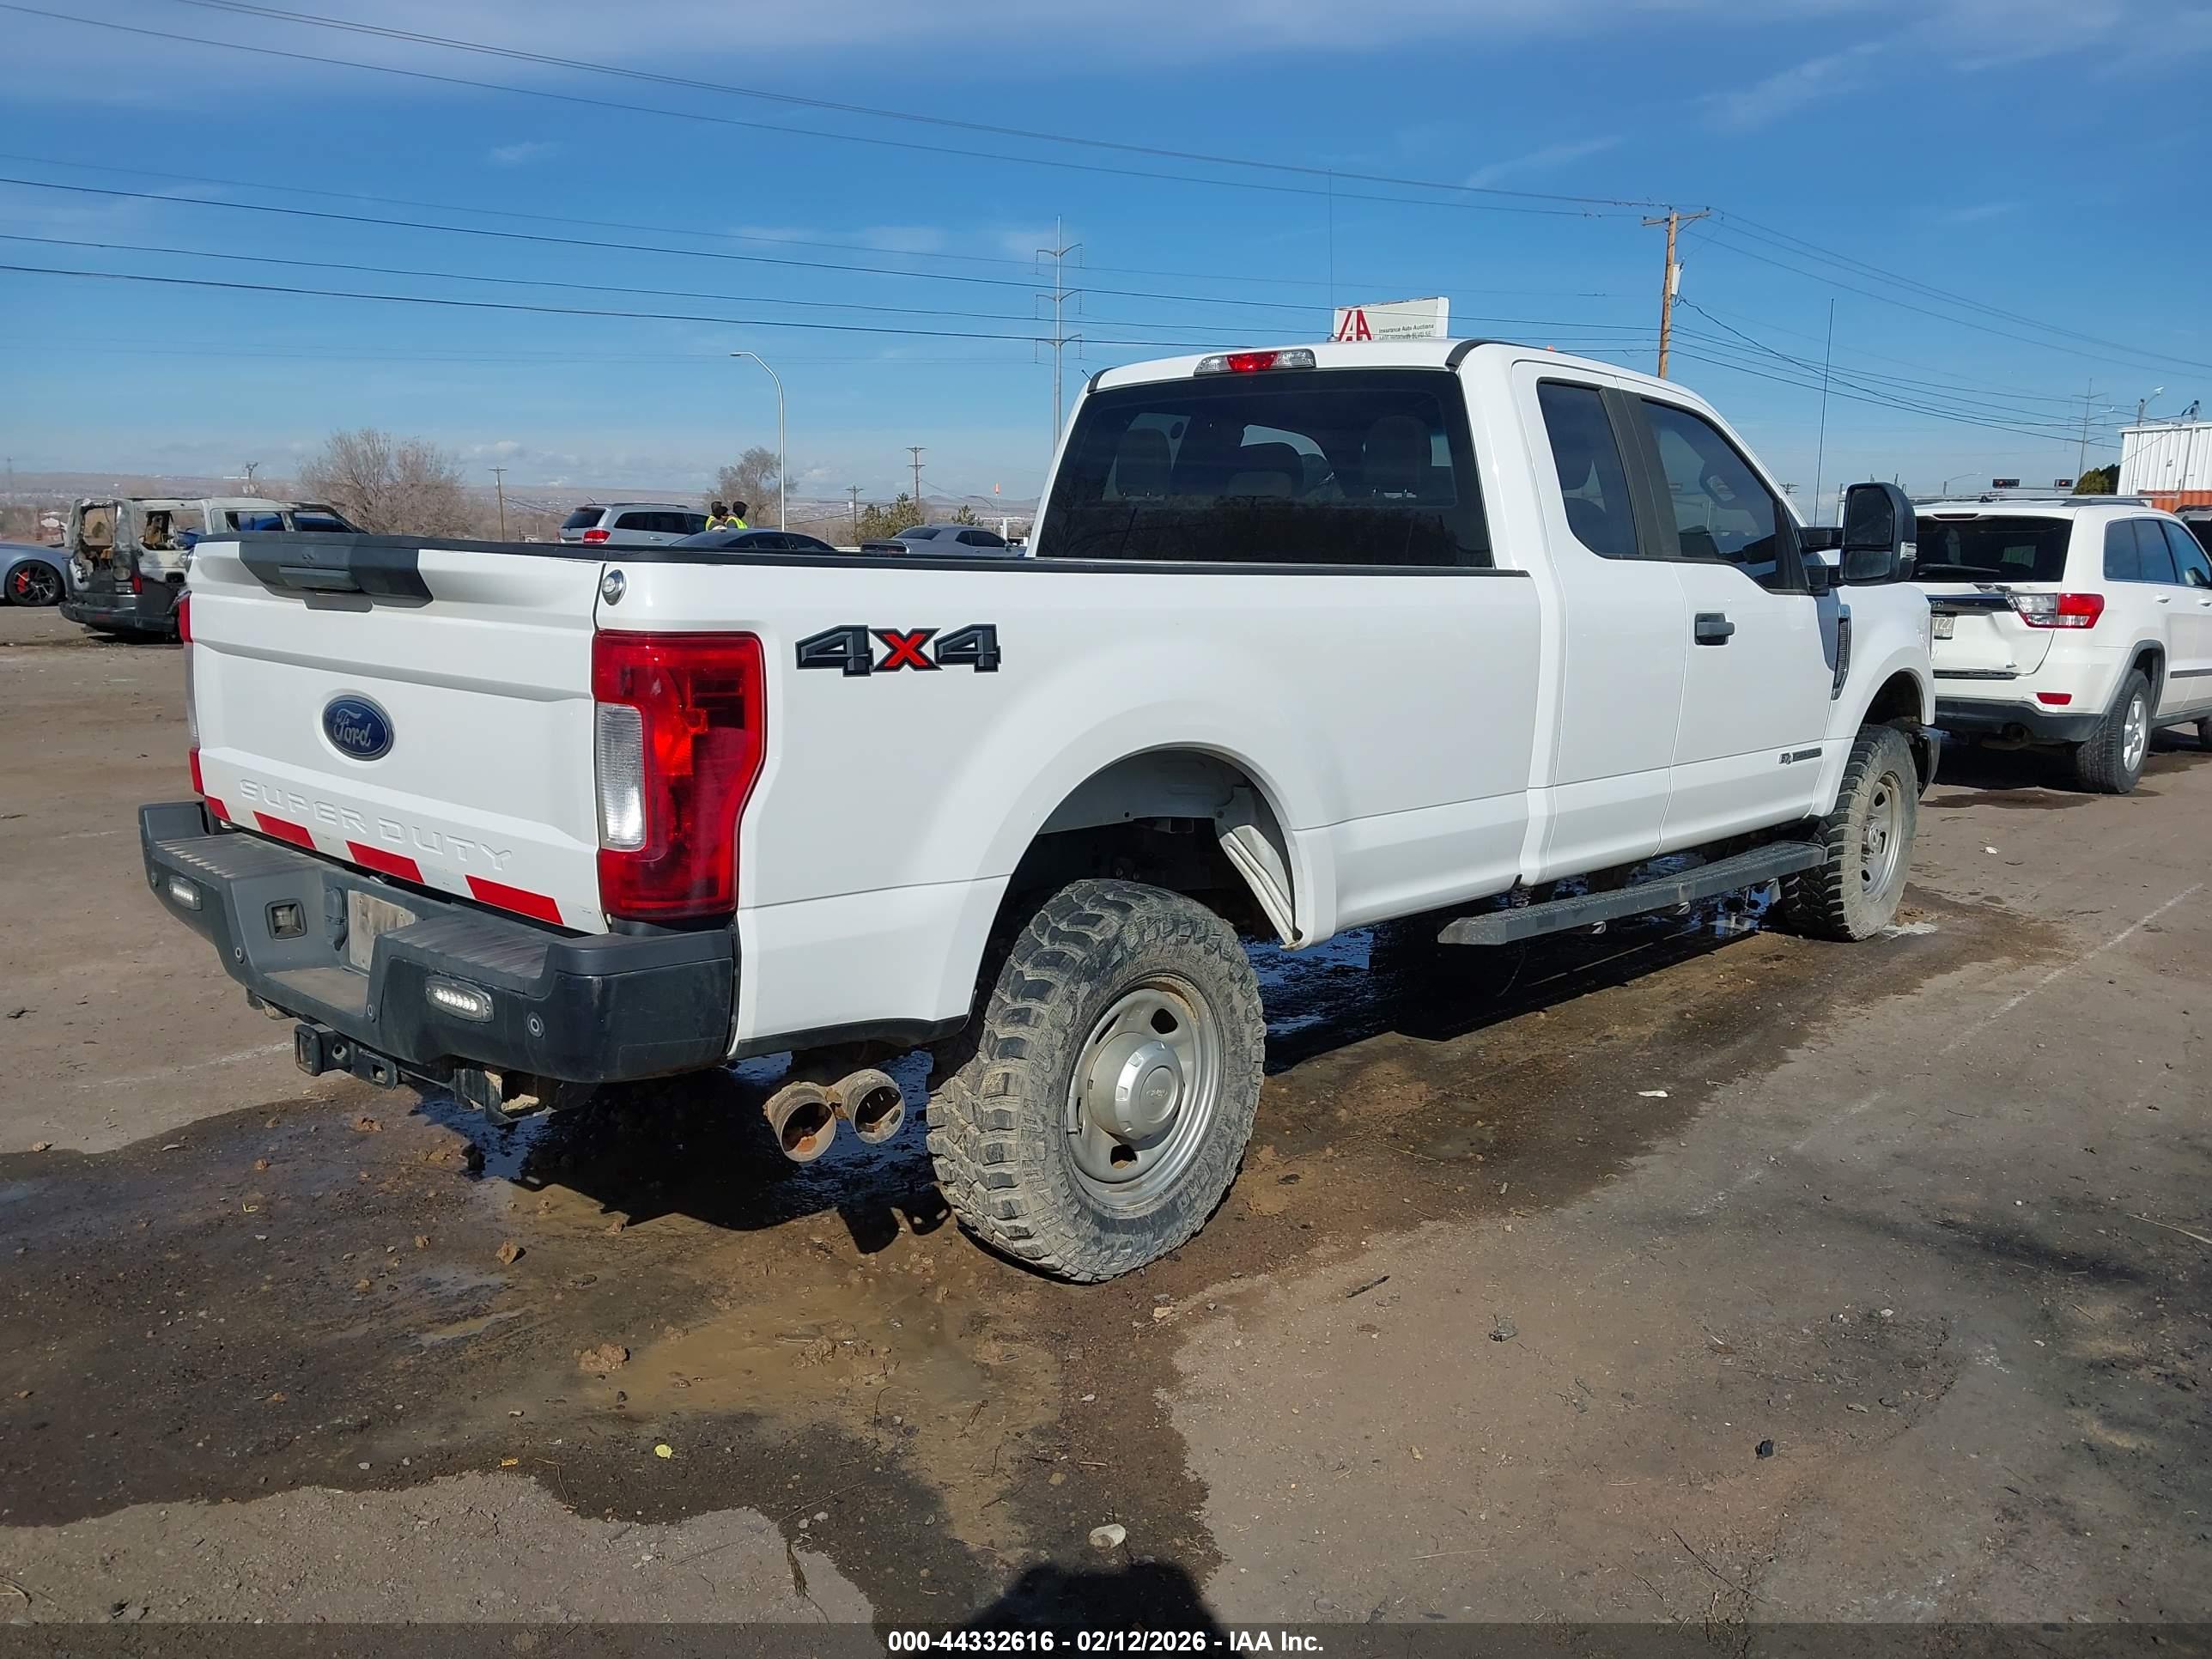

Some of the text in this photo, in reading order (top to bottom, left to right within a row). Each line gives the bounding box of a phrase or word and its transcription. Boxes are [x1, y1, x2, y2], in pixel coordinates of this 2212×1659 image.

[334, 708, 373, 749] Ford
[239, 778, 514, 871] SUPER DUTY
